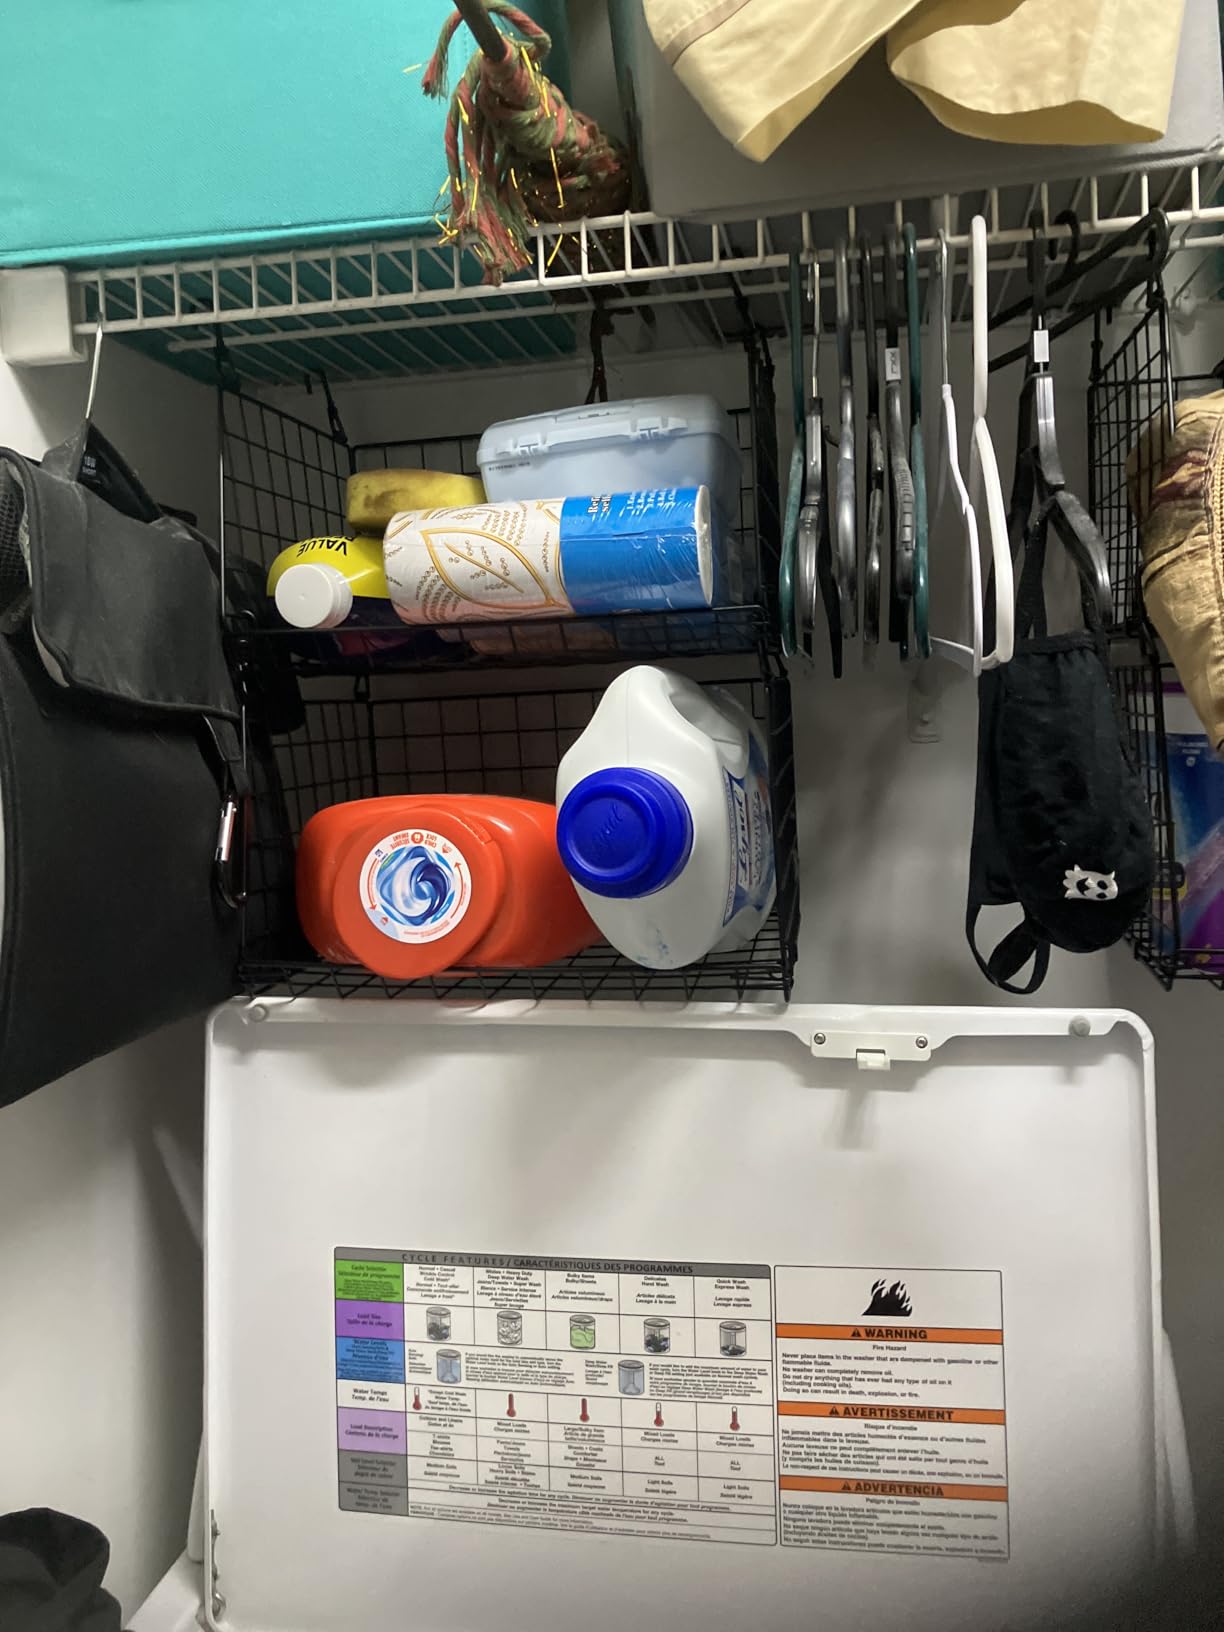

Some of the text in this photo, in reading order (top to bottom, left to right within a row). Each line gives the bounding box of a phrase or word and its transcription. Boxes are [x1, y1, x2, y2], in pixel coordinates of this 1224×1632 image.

[296, 539, 348, 558] VALUE
[402, 1253, 437, 1263] CYCLE
[513, 1258, 601, 1270] CARACTÉRISTIQUES
[603, 1261, 621, 1271] DES
[624, 1263, 693, 1274] PROGRAMMES
[865, 1328, 928, 1339] WARNING
[827, 1368, 860, 1376] completely
[782, 1380, 812, 1388] (including
[843, 1406, 954, 1421] AVERTISSEMENT
[854, 1481, 944, 1497] ADVERTENCIA
